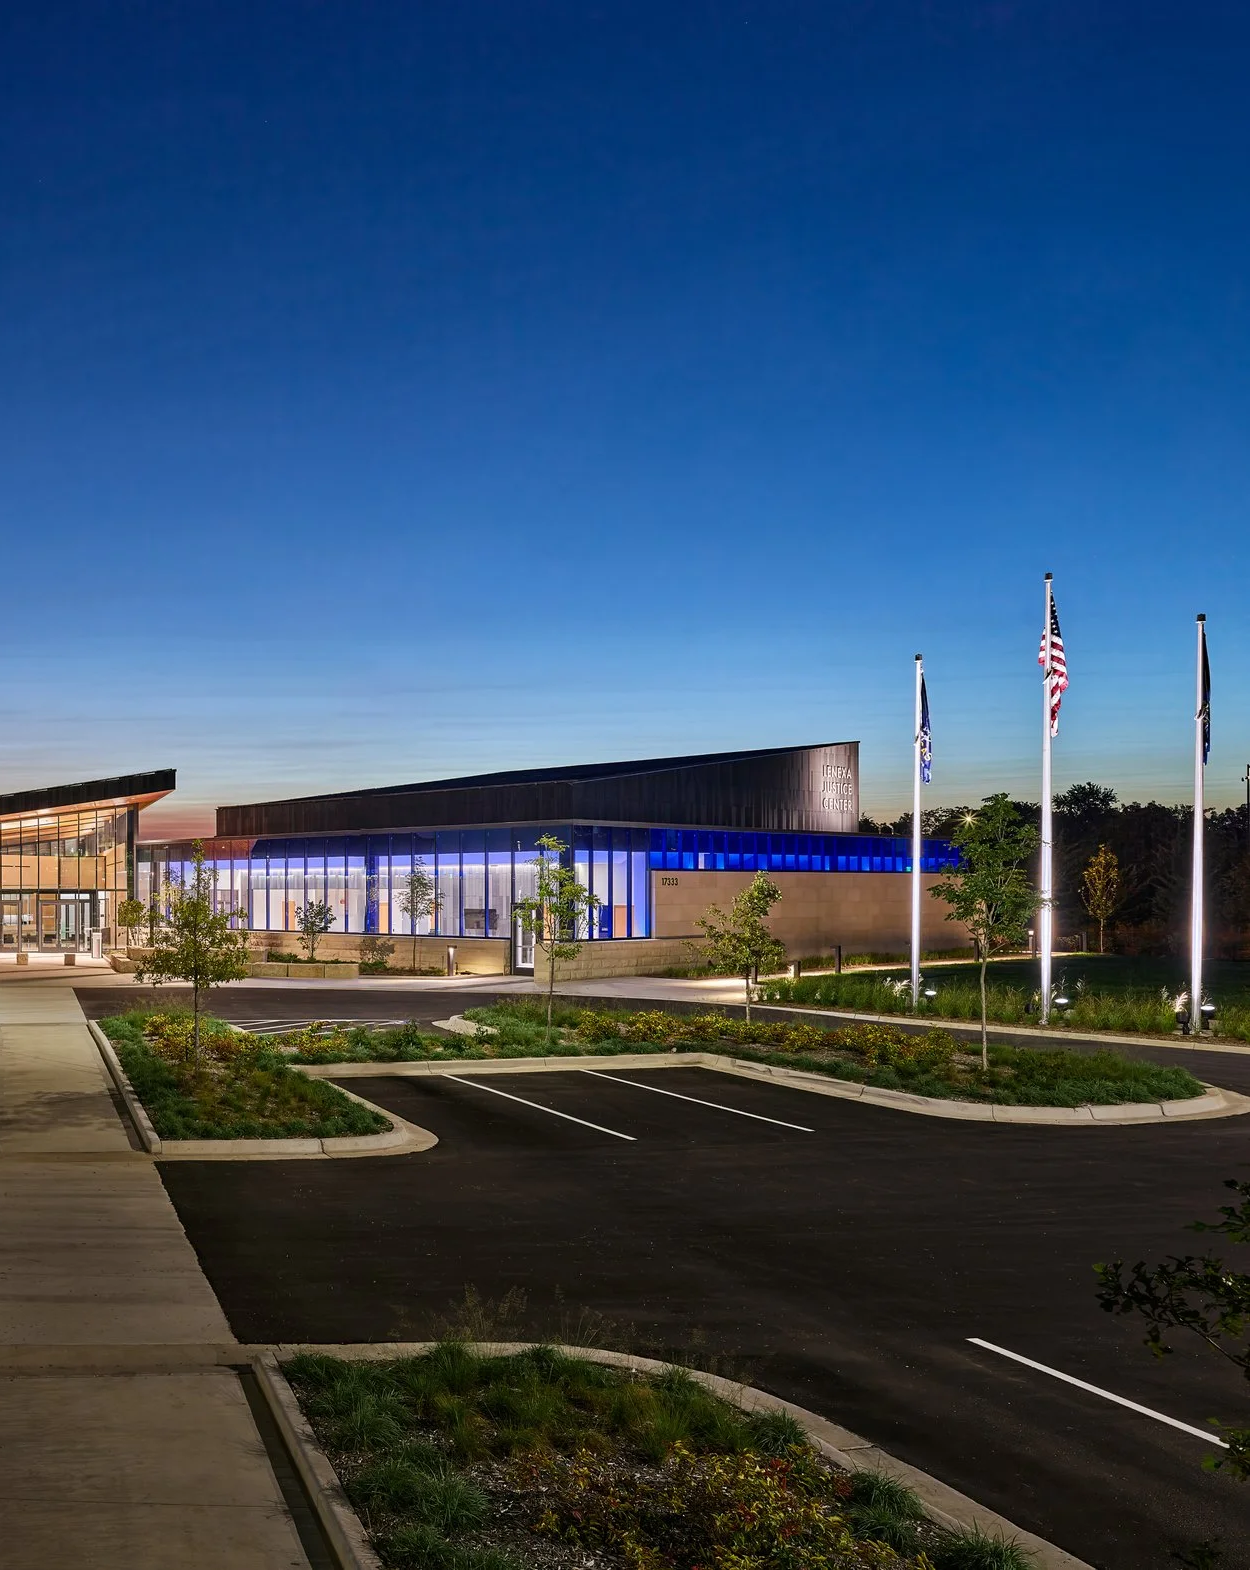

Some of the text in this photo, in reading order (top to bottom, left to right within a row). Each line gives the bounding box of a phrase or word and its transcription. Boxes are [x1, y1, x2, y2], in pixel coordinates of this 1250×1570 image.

[823, 764, 852, 779] LENEXA
[822, 781, 852, 795] JUSTICE
[823, 797, 852, 811] CENTER
[661, 877, 679, 886] 17333
